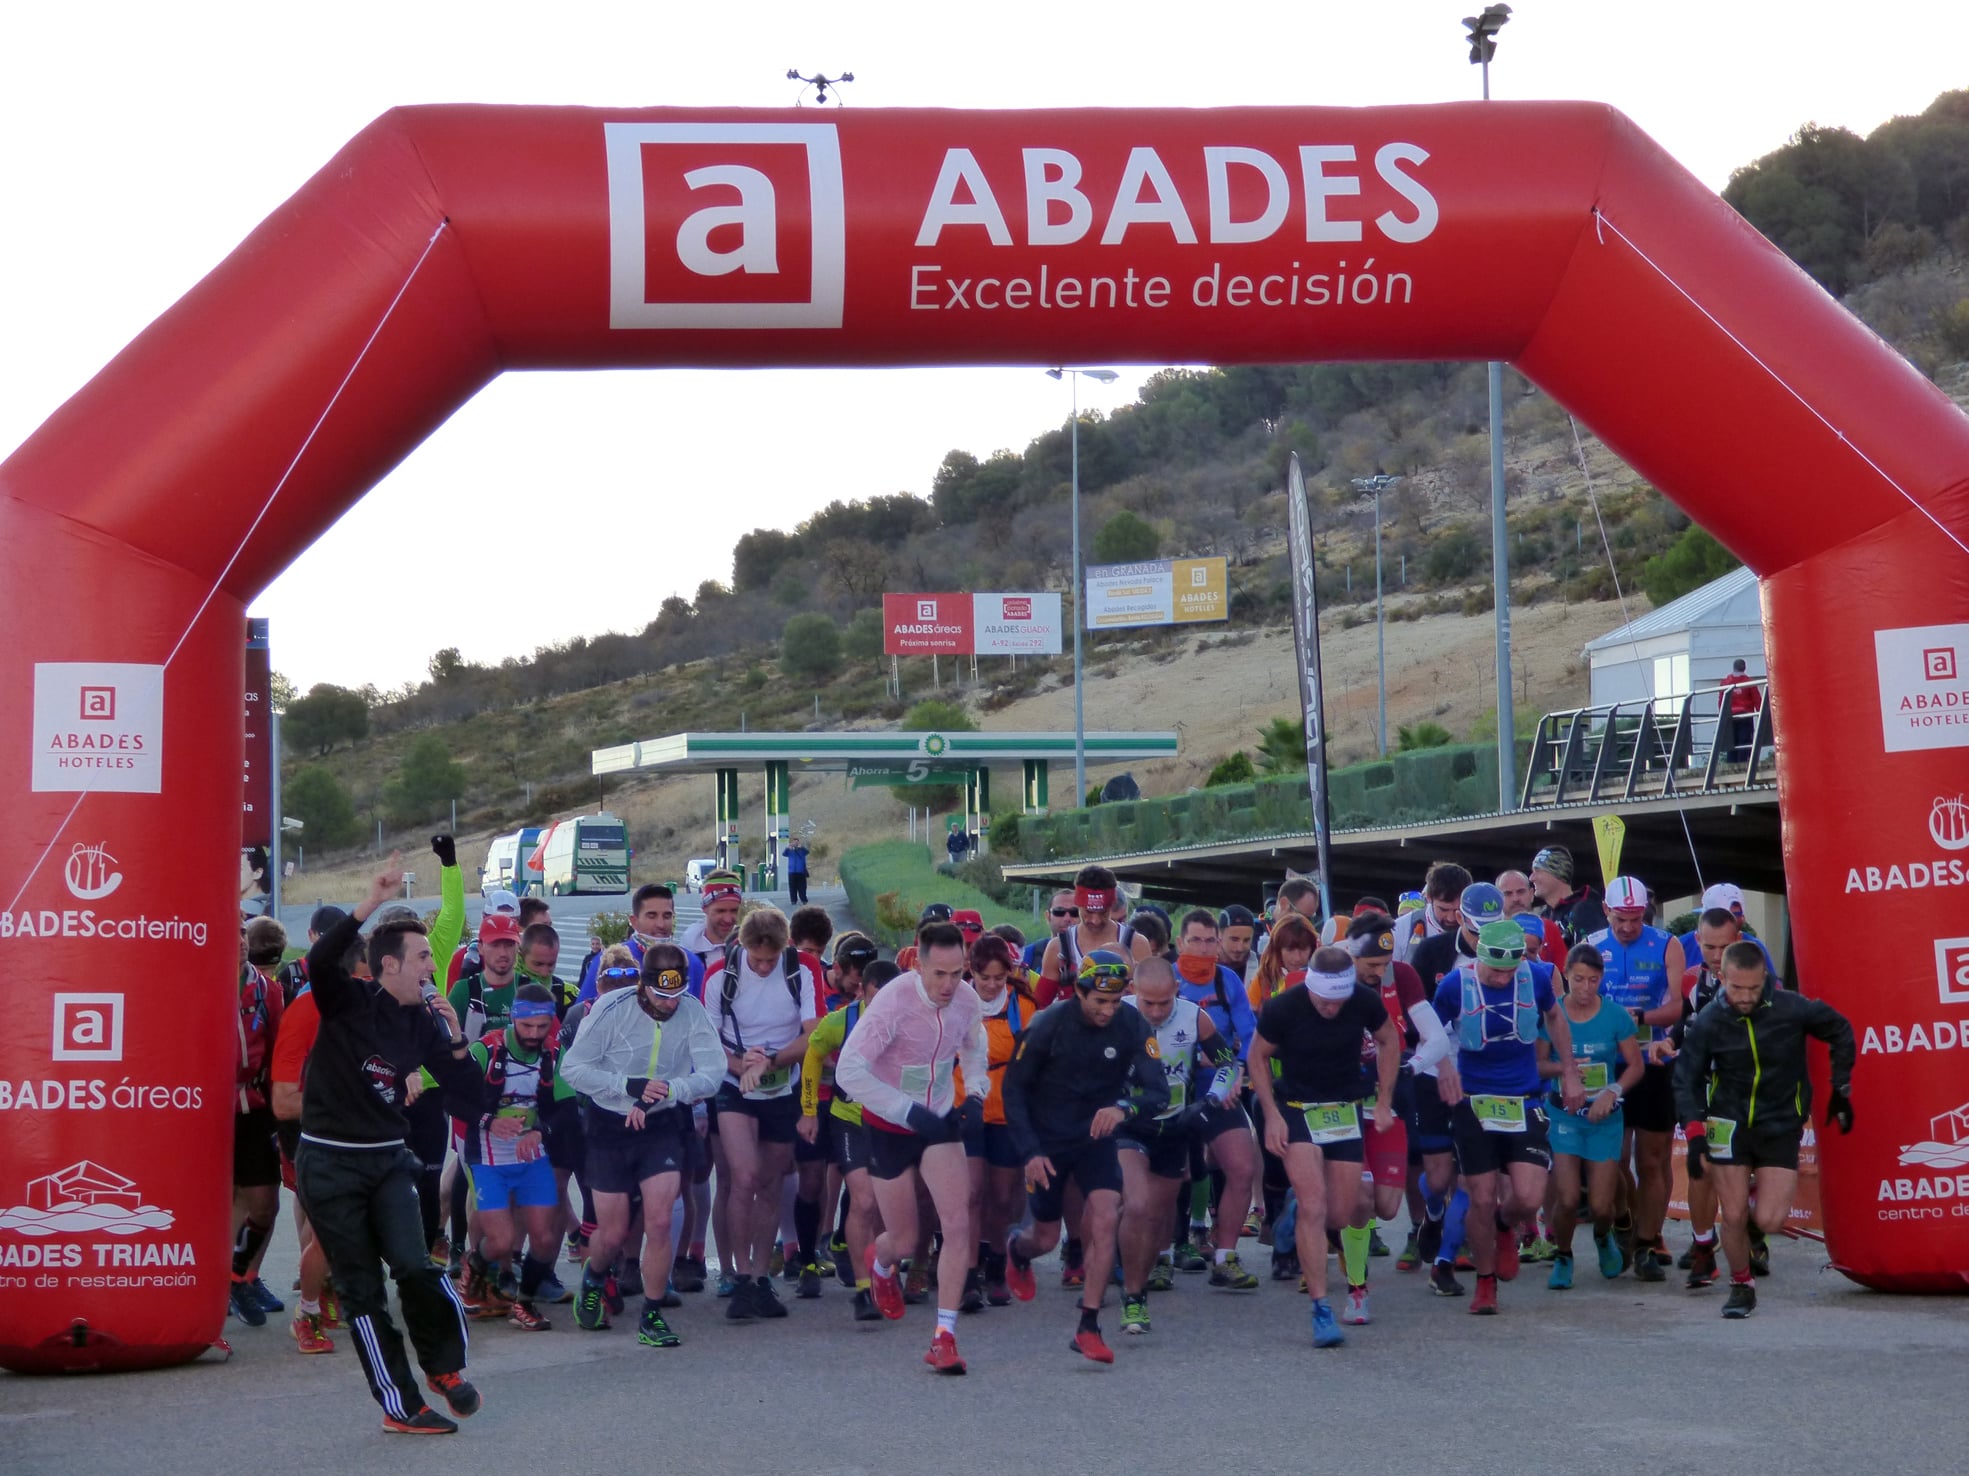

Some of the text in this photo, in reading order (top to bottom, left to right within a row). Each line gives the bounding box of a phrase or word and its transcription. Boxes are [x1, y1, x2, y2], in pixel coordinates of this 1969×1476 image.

[914, 142, 1439, 247] ABADES
[675, 164, 780, 277] a
[910, 257, 1413, 311] Excelente decisión
[1111, 563, 1165, 577] GRANADA
[1181, 592, 1219, 603] ABADES
[1933, 655, 1948, 672] a
[89, 695, 106, 712] a
[1900, 690, 1969, 711] ABADE
[50, 733, 145, 750] ABADES
[58, 756, 135, 769] HOTELES
[850, 767, 890, 776] Ahorra
[905, 759, 931, 781] 5
[71, 1008, 105, 1044] a
[111, 1076, 203, 1109] áreas
[1323, 1110, 1341, 1124] 58
[1491, 1103, 1507, 1116] 15
[1878, 1207, 1944, 1221] centro
[92, 1243, 197, 1267] TRIANA
[34, 1273, 59, 1288] de
[67, 1271, 197, 1288] restauración
